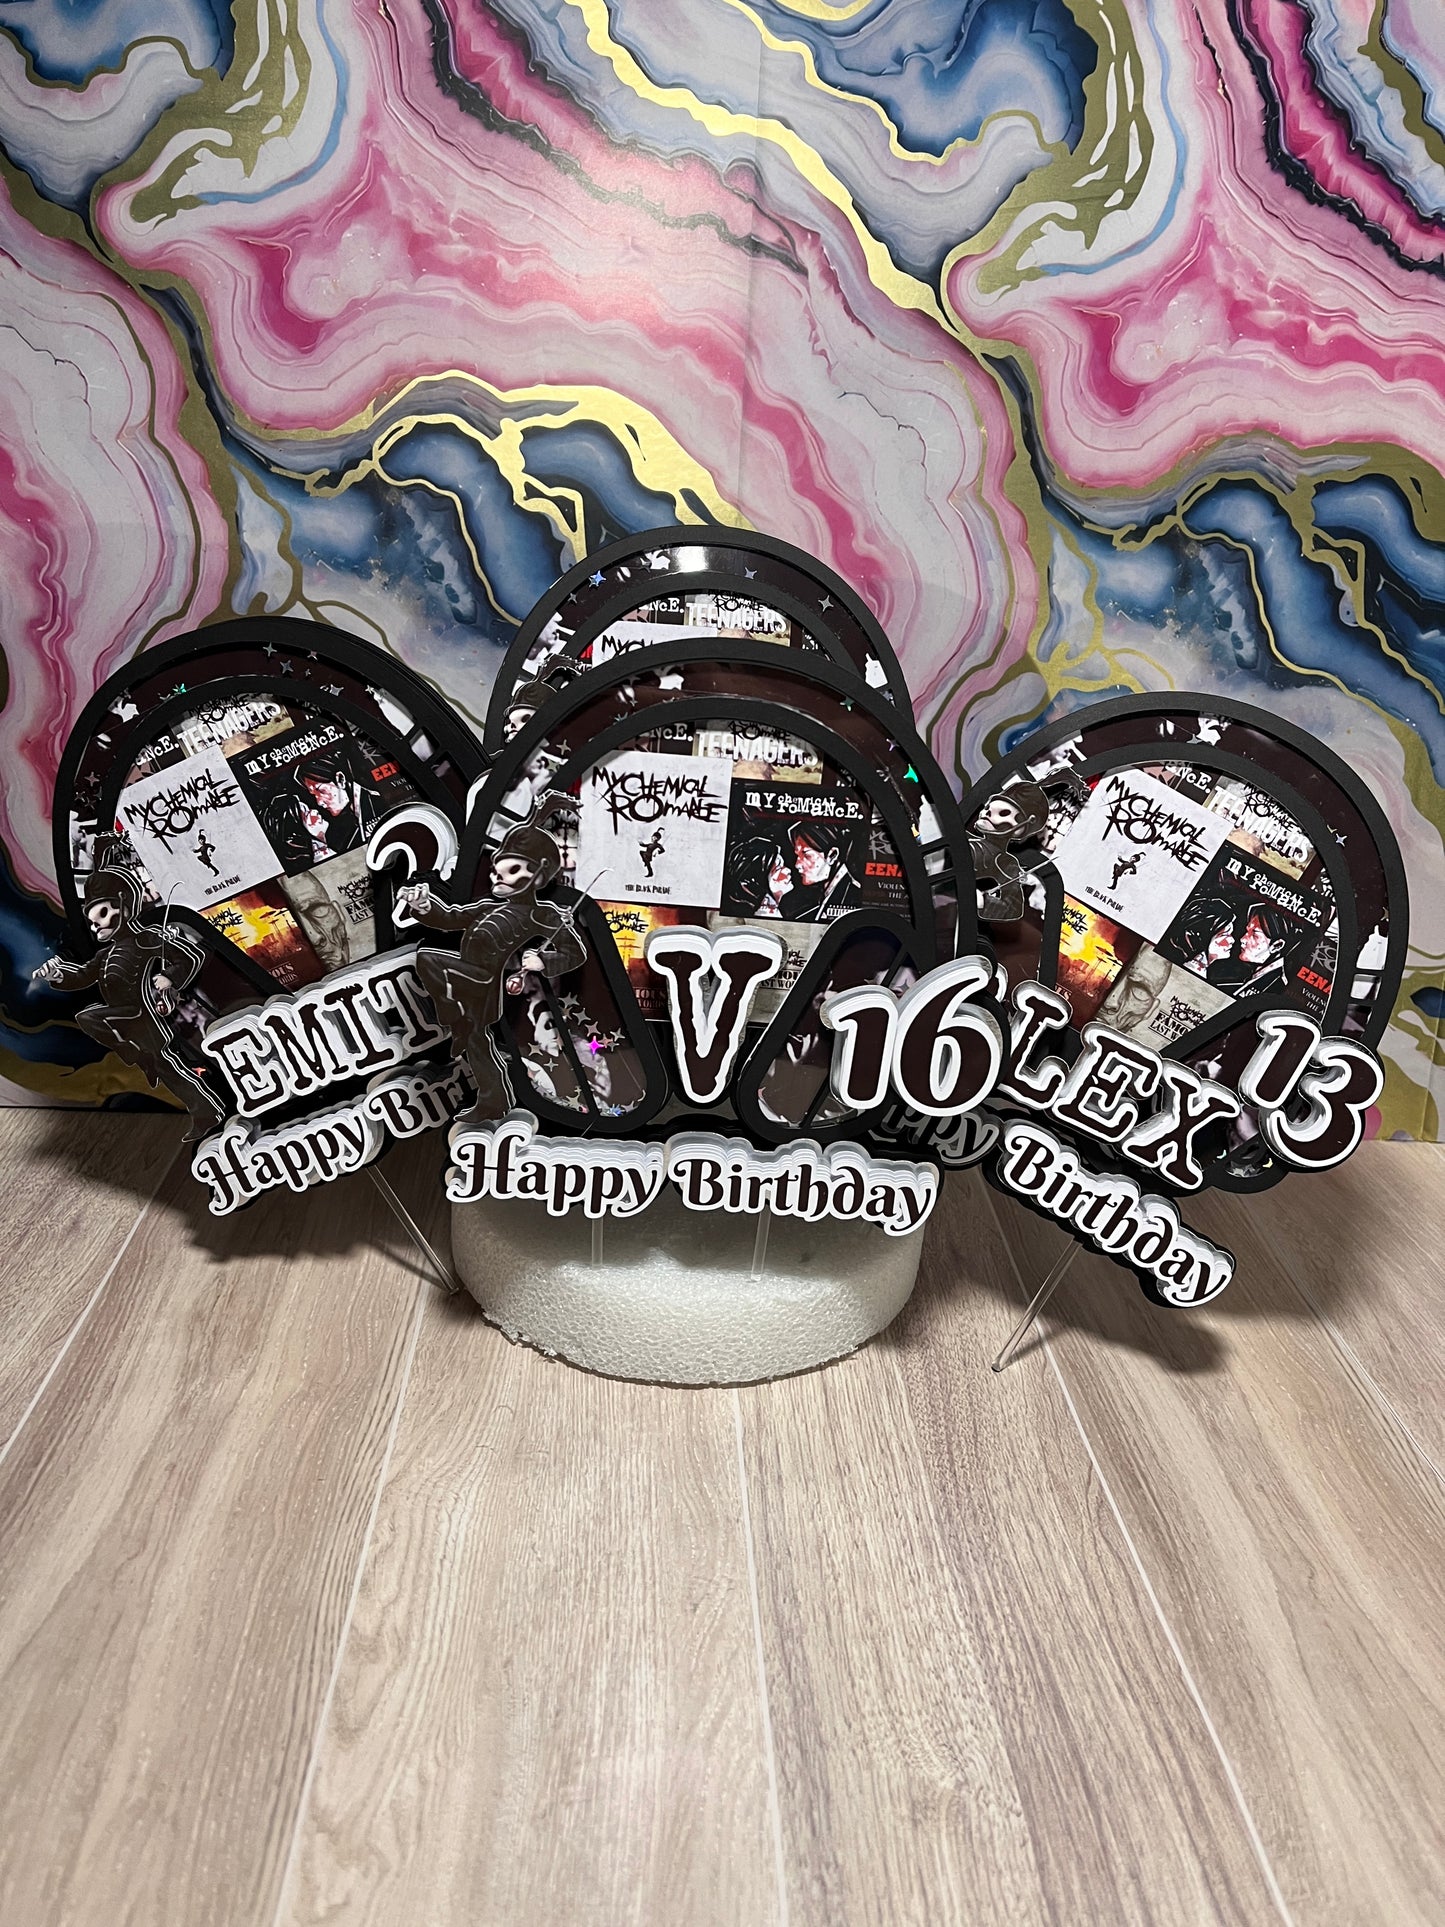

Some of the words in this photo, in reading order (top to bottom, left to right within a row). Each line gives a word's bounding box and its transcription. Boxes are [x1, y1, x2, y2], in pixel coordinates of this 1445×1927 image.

[648, 932, 783, 1103] V
[829, 958, 1001, 1116] 16
[998, 978, 1241, 1191] LEX
[1239, 1010, 1384, 1168] 13
[194, 1112, 367, 1215] Happy
[448, 1134, 664, 1219] Happy
[667, 1150, 937, 1235] Birthday
[1002, 1122, 1235, 1308] Birthday
